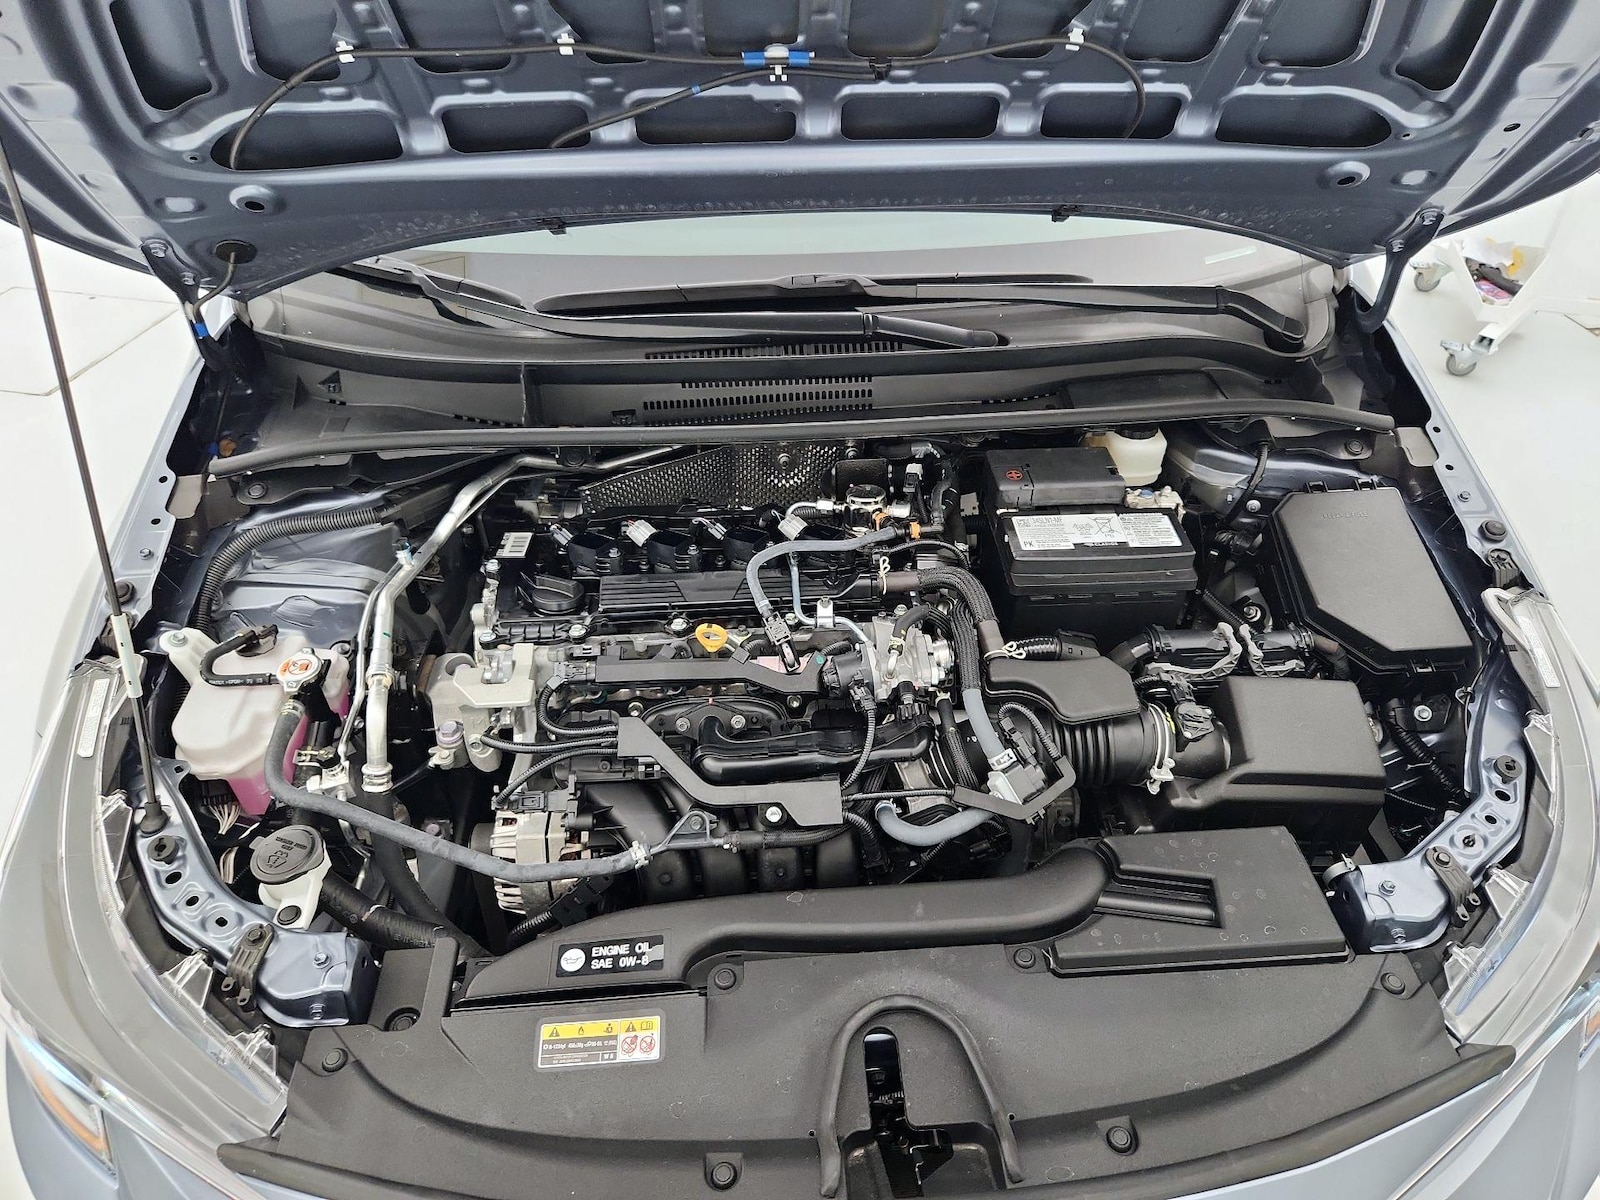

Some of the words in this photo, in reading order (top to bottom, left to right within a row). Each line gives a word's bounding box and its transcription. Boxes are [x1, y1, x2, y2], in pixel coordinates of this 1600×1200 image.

[592, 943, 630, 957] ENGINE
[635, 941, 652, 953] OIL
[591, 957, 613, 970] SAE
[619, 955, 649, 968] 0W-8
